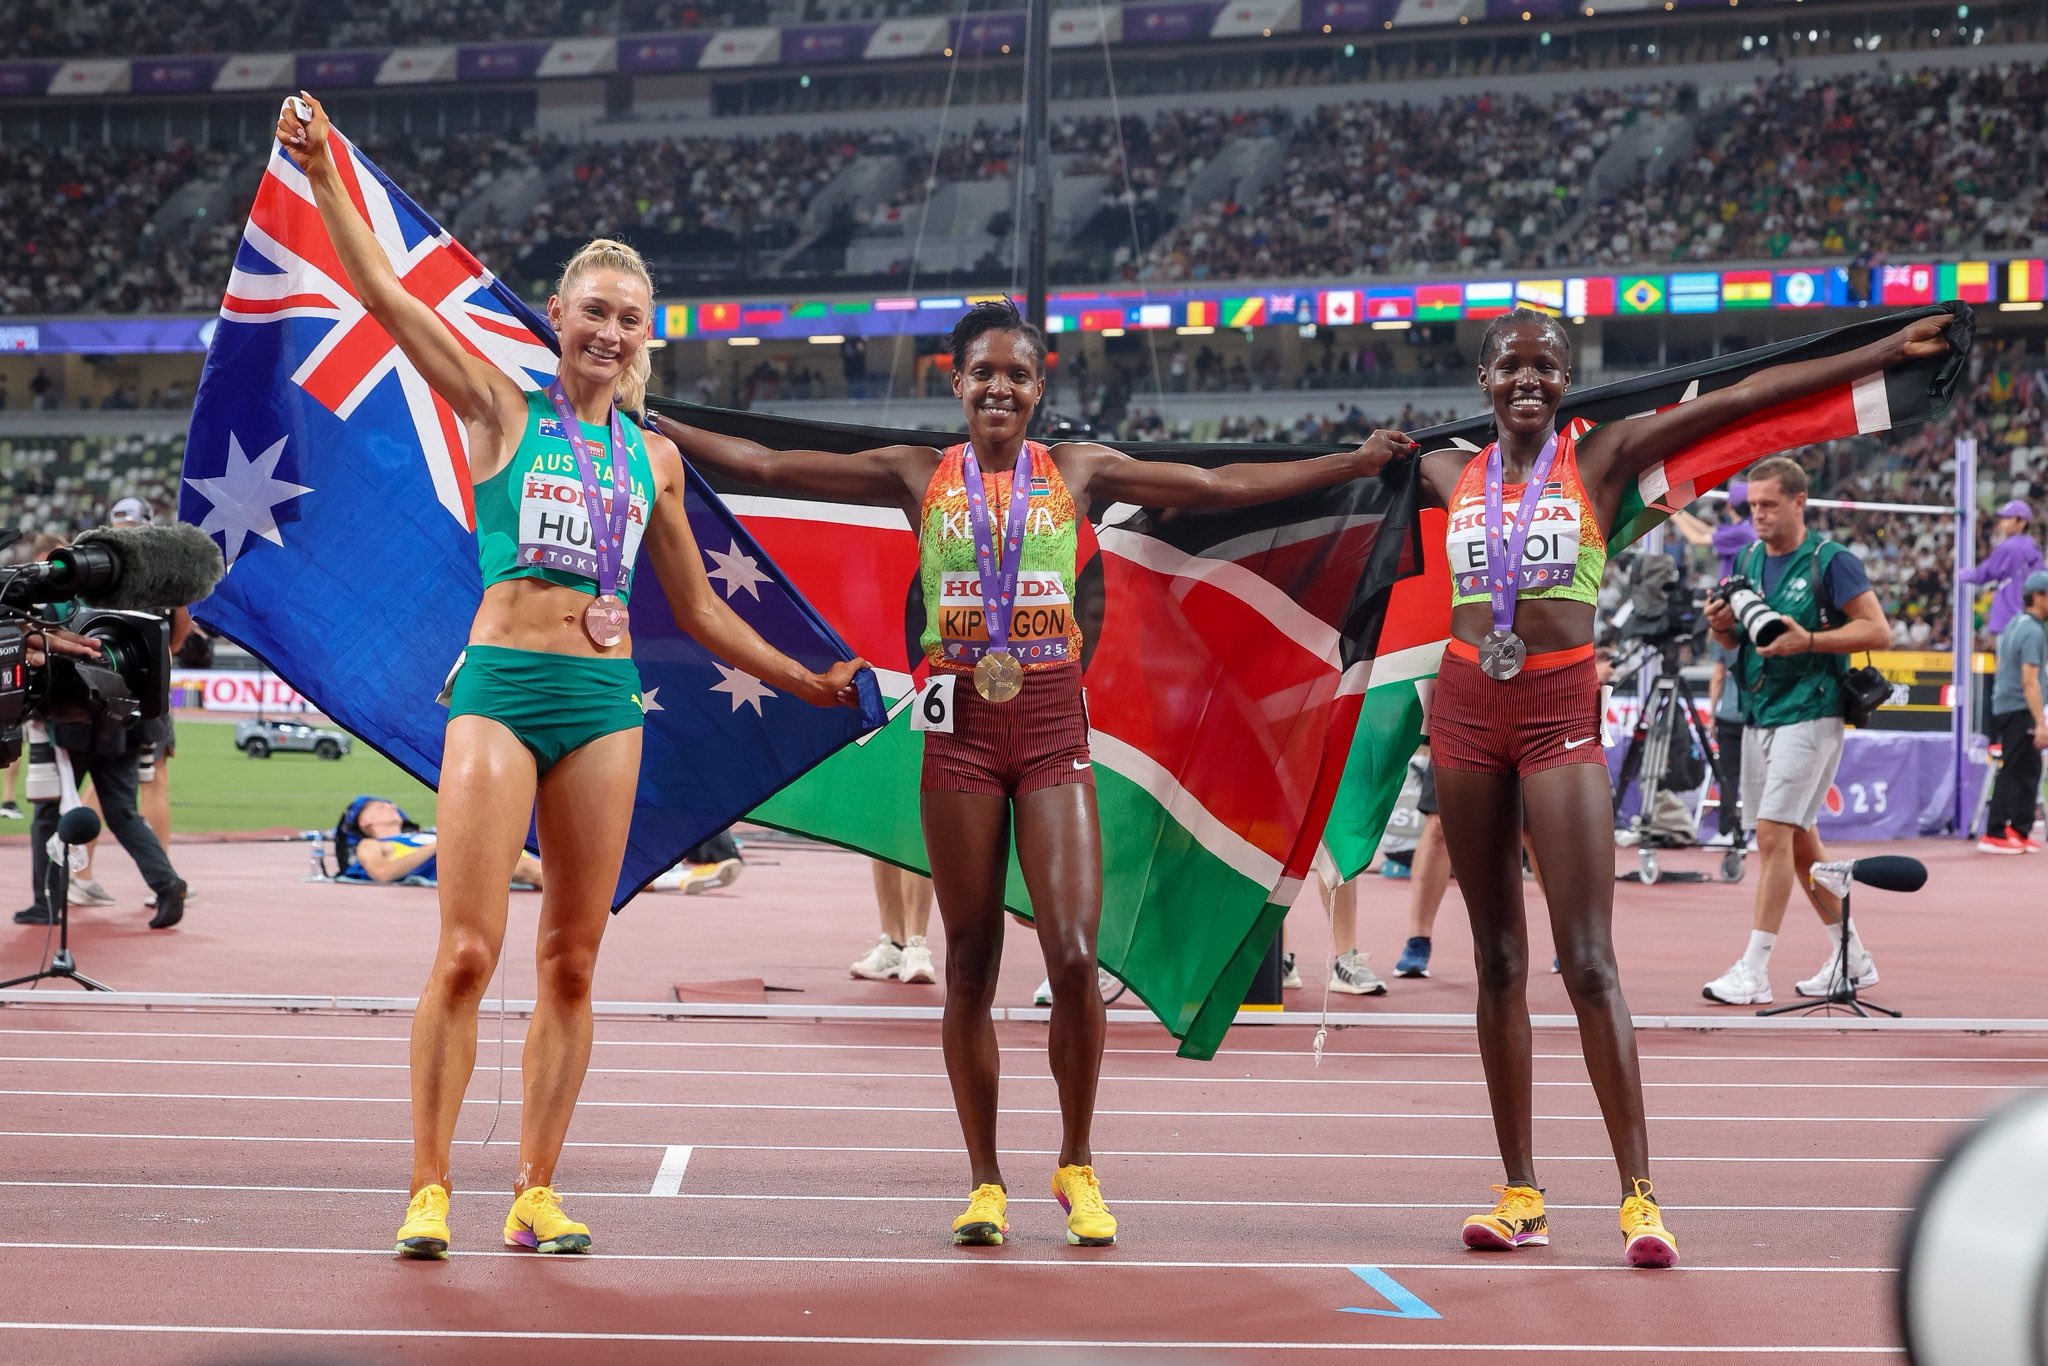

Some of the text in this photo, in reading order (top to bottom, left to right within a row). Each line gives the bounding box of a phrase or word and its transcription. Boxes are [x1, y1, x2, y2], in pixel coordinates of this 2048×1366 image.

[530, 453, 646, 501] AUSRAIA
[525, 482, 643, 525] HOA
[548, 551, 598, 573] TOKY
[1467, 534, 1558, 568] EOI
[944, 580, 1064, 597] HODA
[945, 609, 1065, 637] KIPGON
[201, 680, 305, 704] OND
[923, 683, 945, 724] 6
[1849, 782, 1888, 813] 25
